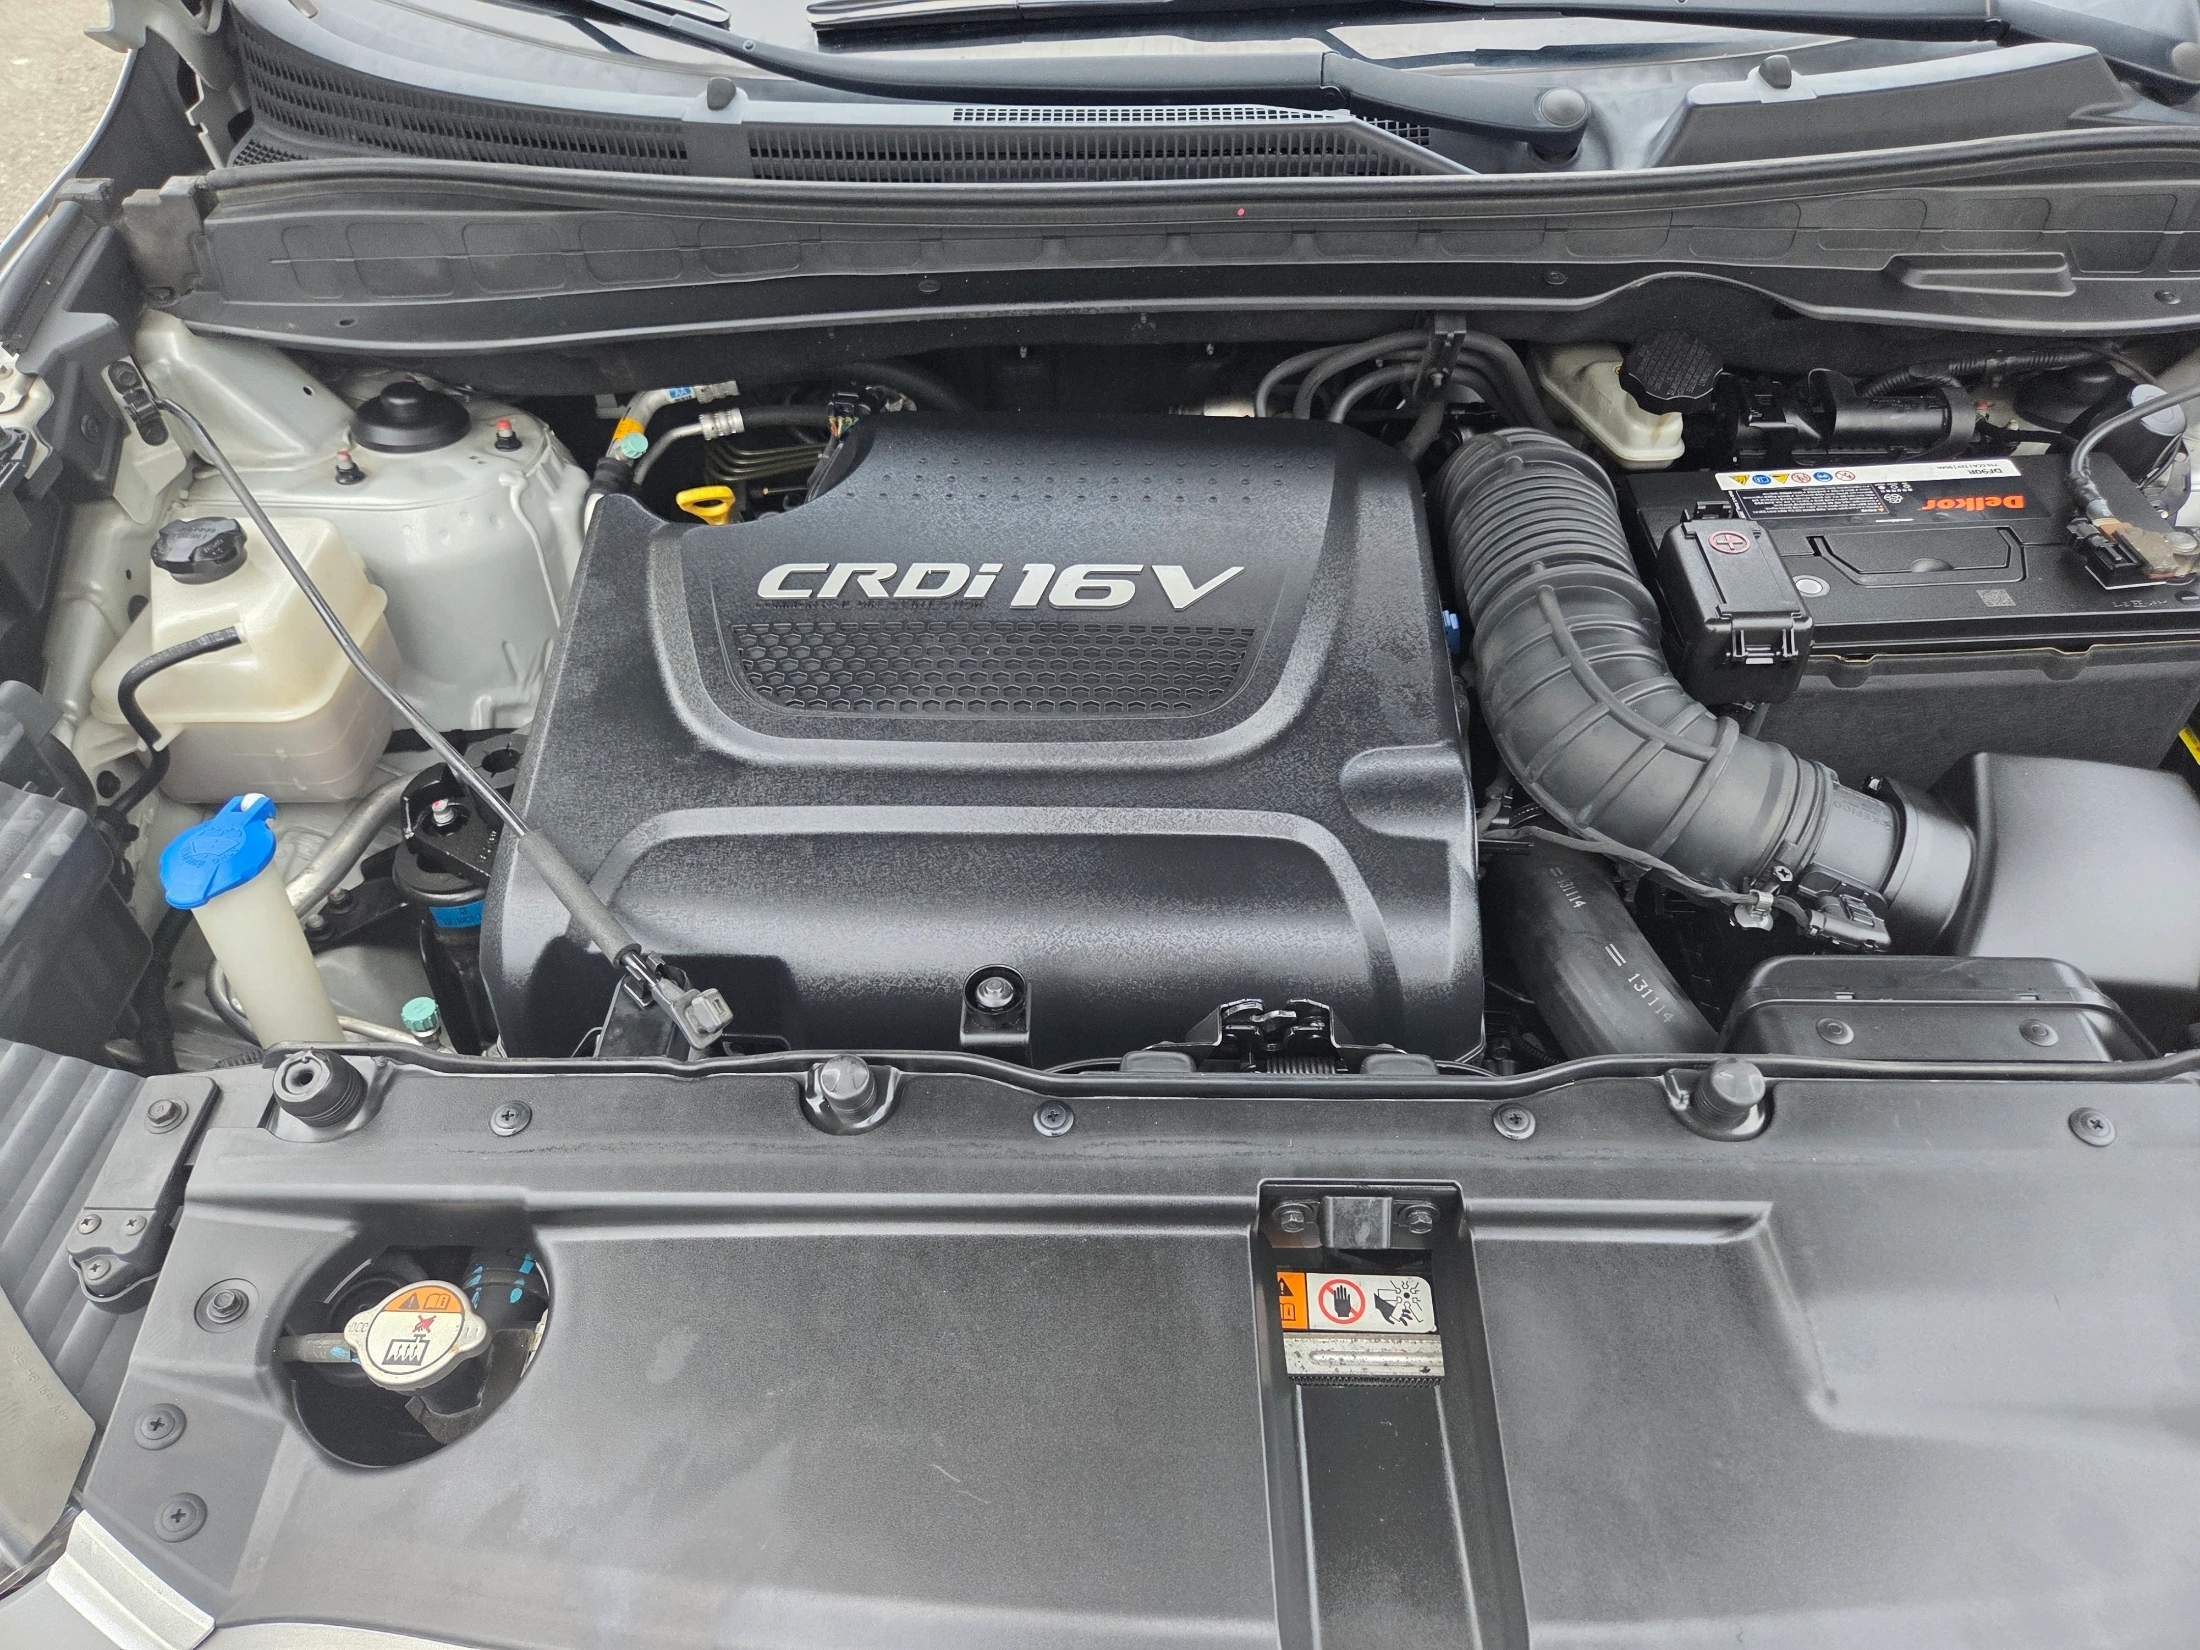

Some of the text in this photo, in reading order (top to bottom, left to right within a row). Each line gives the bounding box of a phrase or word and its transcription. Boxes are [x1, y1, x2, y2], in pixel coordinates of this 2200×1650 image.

[1920, 495, 2025, 512] Delkor
[756, 562, 1004, 601] CRDi
[1557, 878, 1587, 909] 131114
[1627, 972, 1675, 1024] 131114
